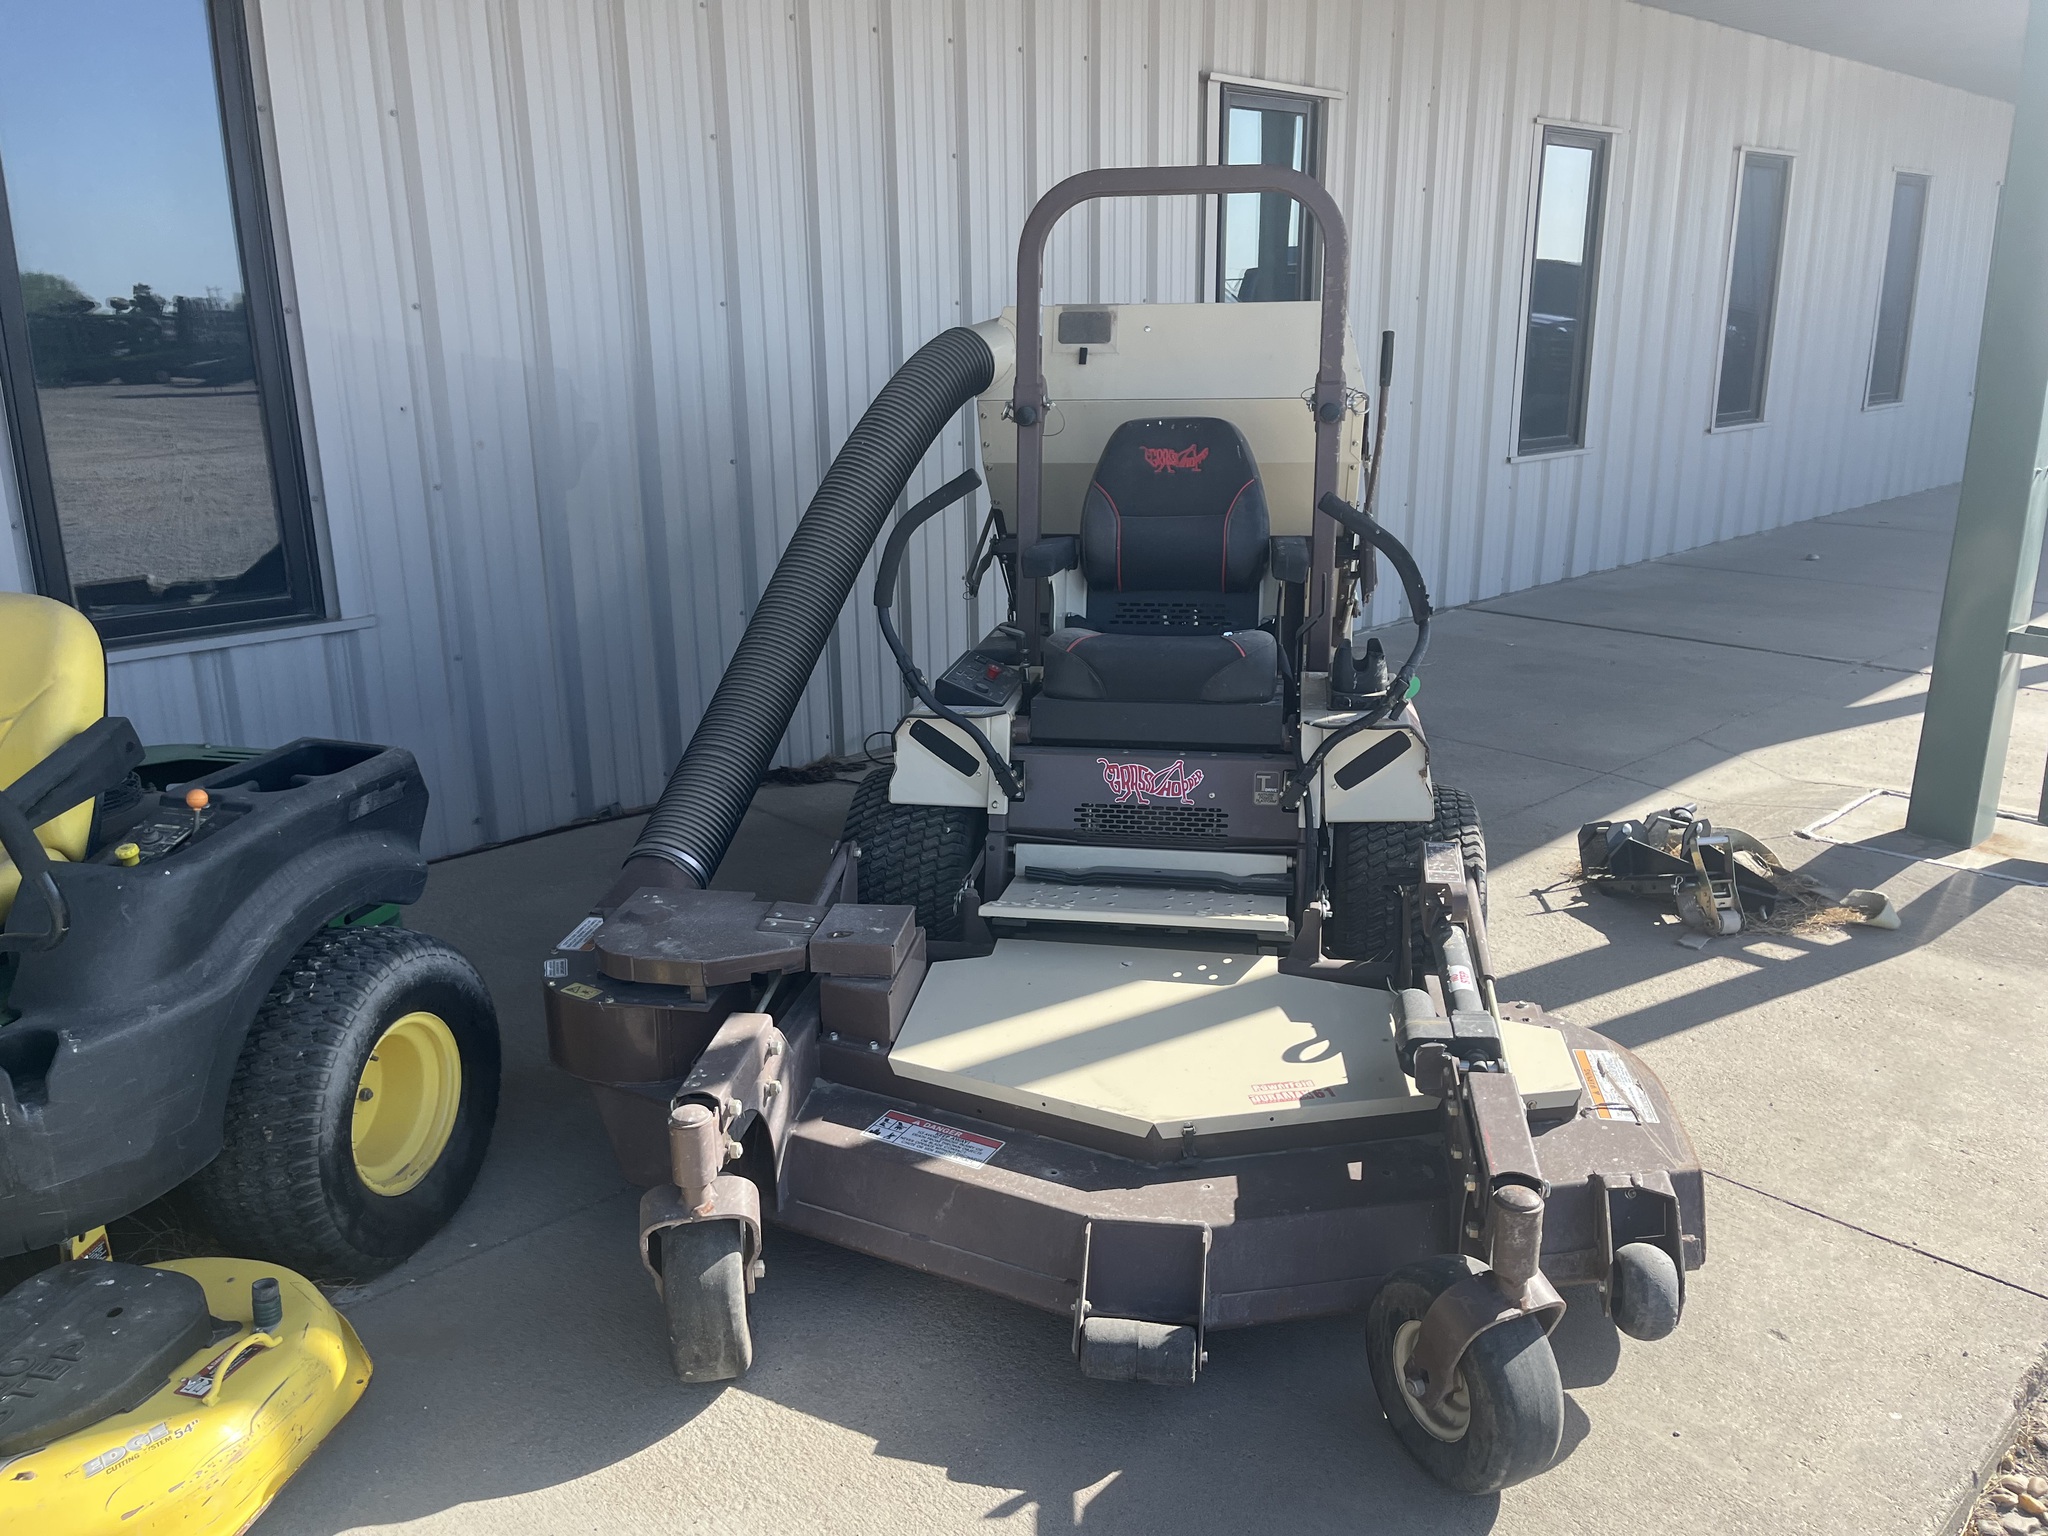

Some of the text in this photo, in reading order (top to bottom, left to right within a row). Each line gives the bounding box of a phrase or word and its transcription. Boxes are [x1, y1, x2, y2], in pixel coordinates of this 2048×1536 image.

[1097, 758, 1205, 804] GRASSHOPPER
[921, 1122, 963, 1137] DANGER
[83, 1422, 169, 1479] EDGE
[106, 1453, 140, 1475] CUTTING
[174, 1419, 199, 1440] 54"
